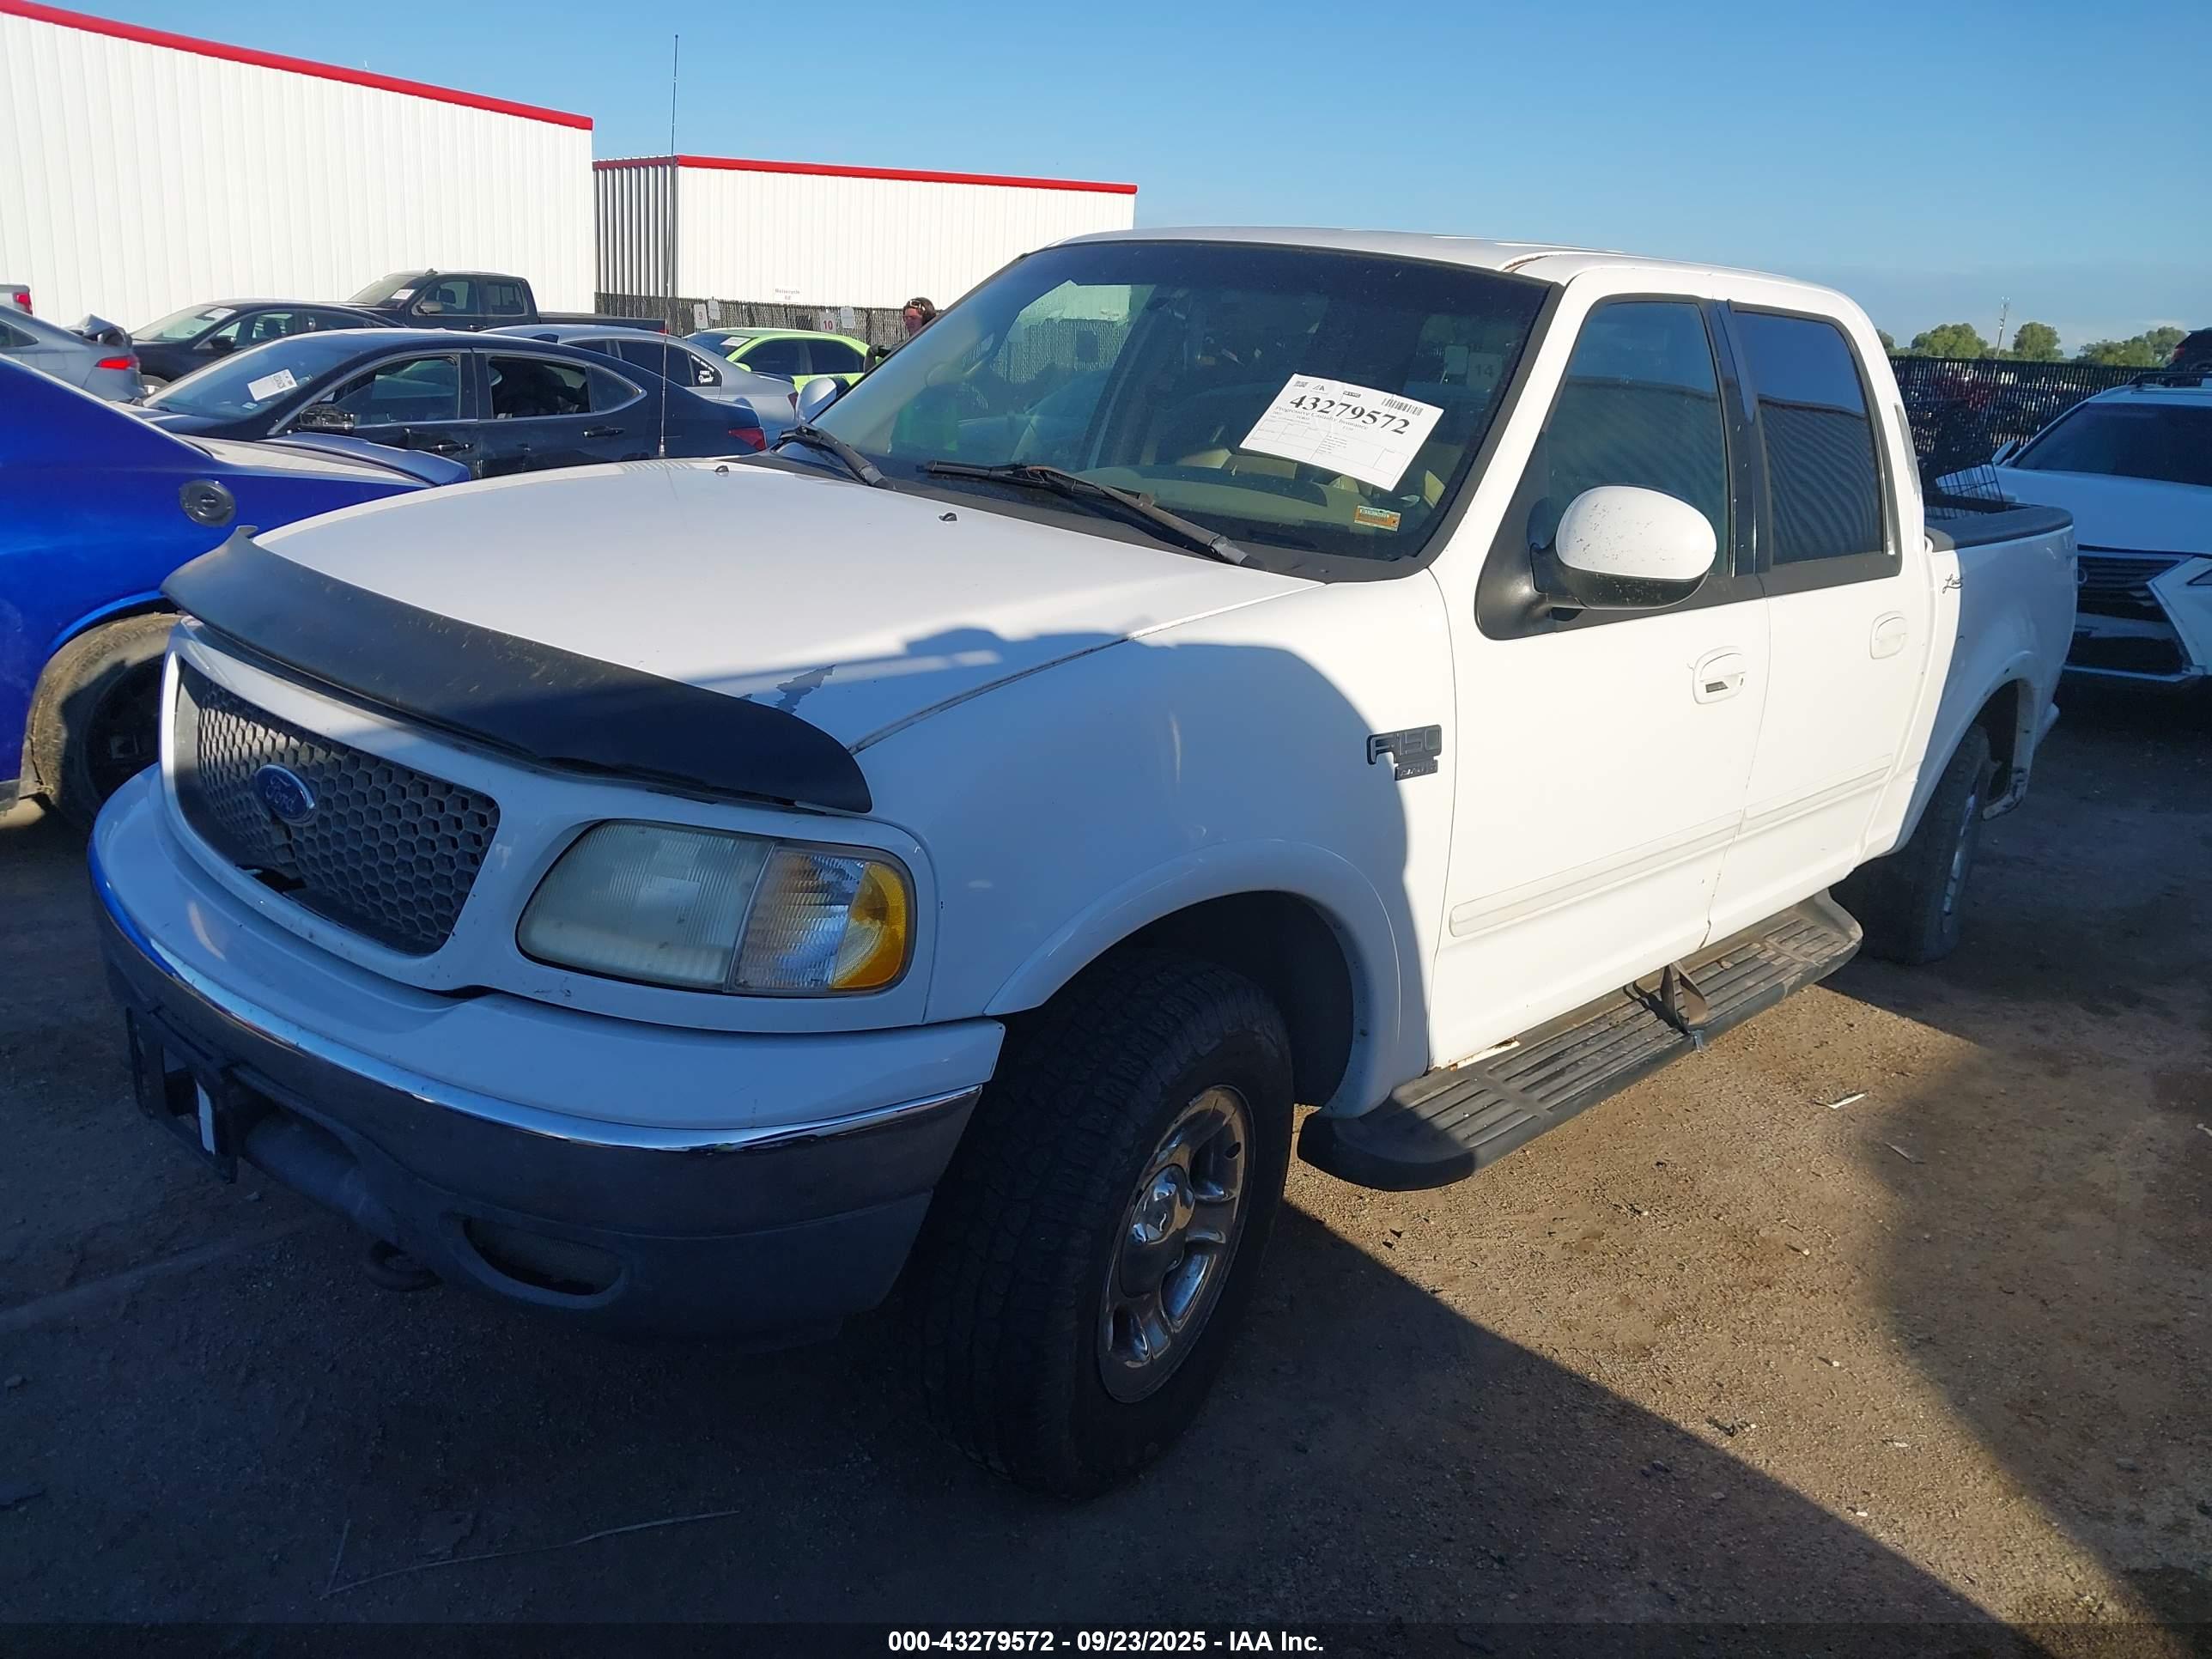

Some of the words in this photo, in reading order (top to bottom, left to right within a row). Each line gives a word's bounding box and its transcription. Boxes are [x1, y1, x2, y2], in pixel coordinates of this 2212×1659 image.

[698, 311, 703, 320] 9
[823, 319, 834, 331] 10
[1474, 363, 1493, 379] 14
[1289, 394, 1411, 435] 43279572
